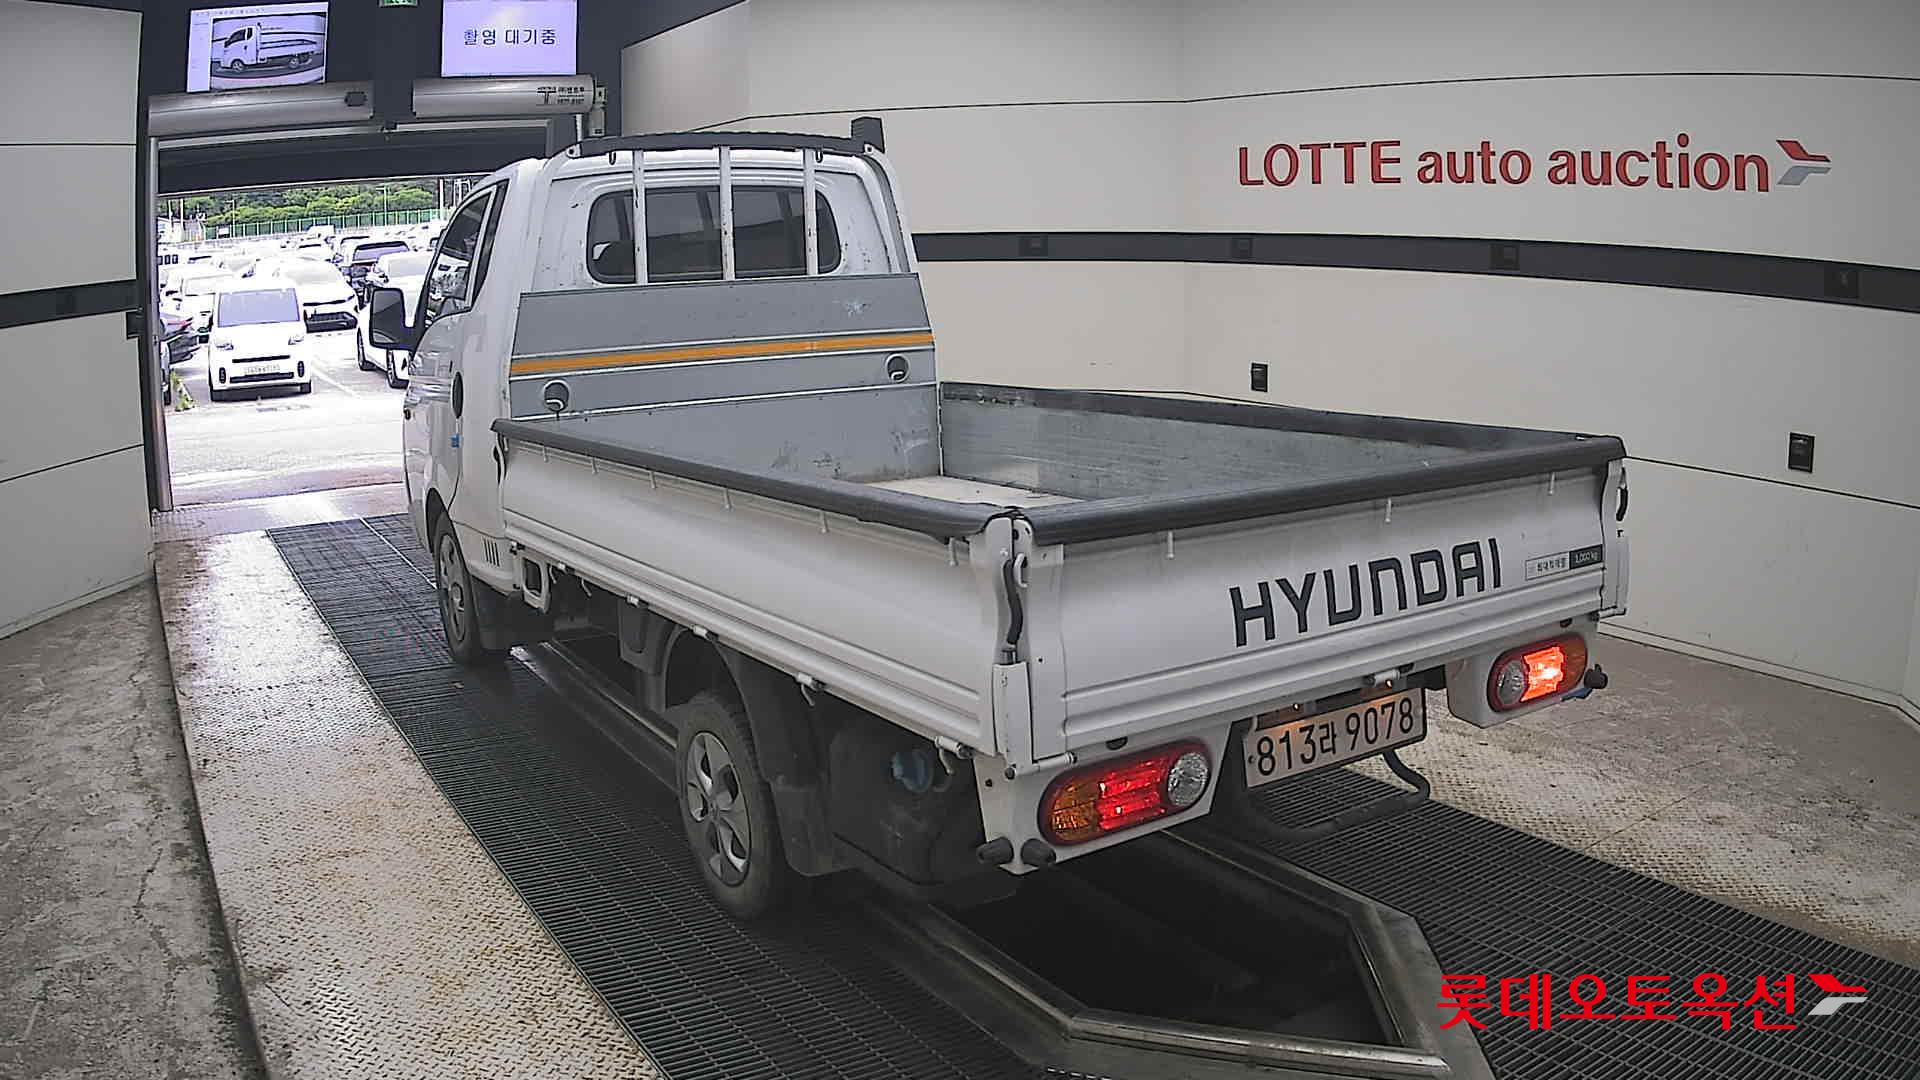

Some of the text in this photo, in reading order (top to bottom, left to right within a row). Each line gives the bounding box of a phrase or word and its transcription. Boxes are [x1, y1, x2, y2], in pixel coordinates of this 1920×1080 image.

[463, 29, 557, 46] 촬영 대기중
[1238, 133, 1770, 192] LOTTE auto auction
[1229, 538, 1501, 648] HYUNDAI
[1256, 697, 1414, 776] 813라 9078
